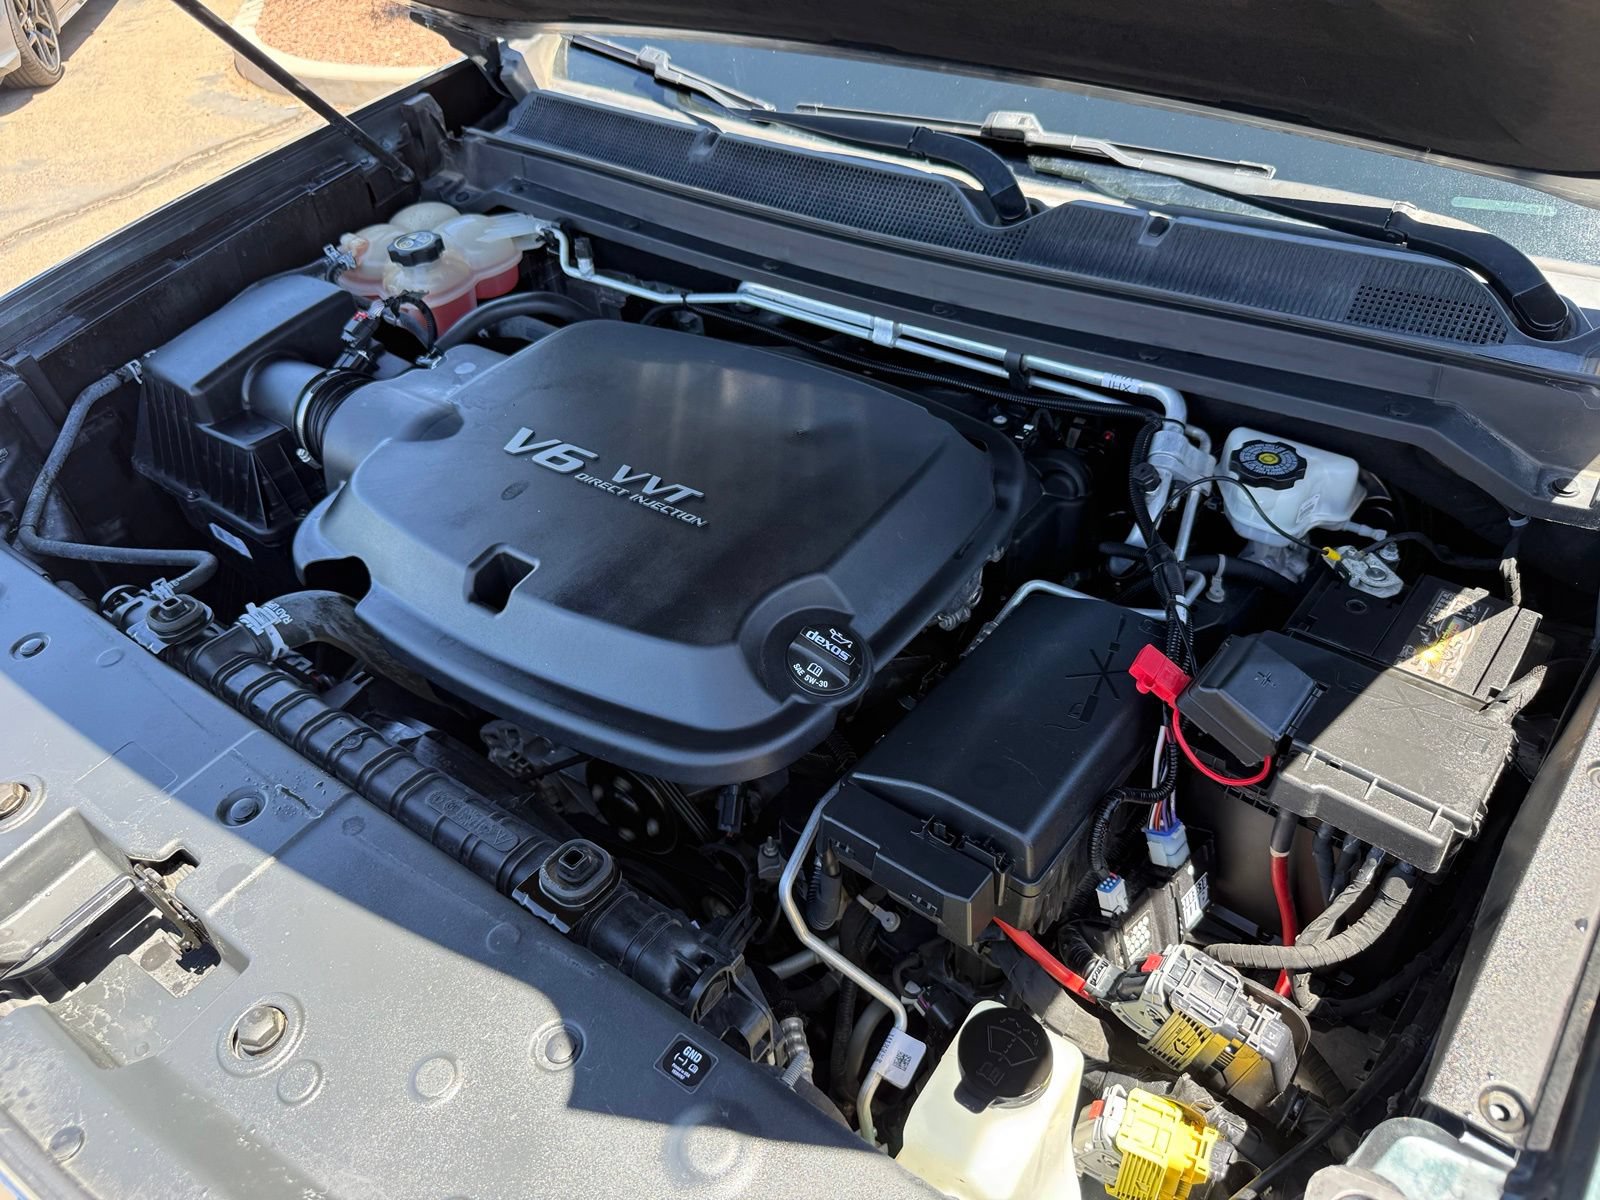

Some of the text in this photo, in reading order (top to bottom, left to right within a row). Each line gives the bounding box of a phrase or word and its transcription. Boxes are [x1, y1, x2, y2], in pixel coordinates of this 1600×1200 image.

[503, 427, 705, 504] V6 VVT
[574, 472, 711, 528] DIRECT INJECTION
[275, 606, 293, 624] RAD
[805, 630, 850, 661] dexos
[793, 663, 828, 688] SAE 5W-30
[682, 1046, 702, 1063] GND
